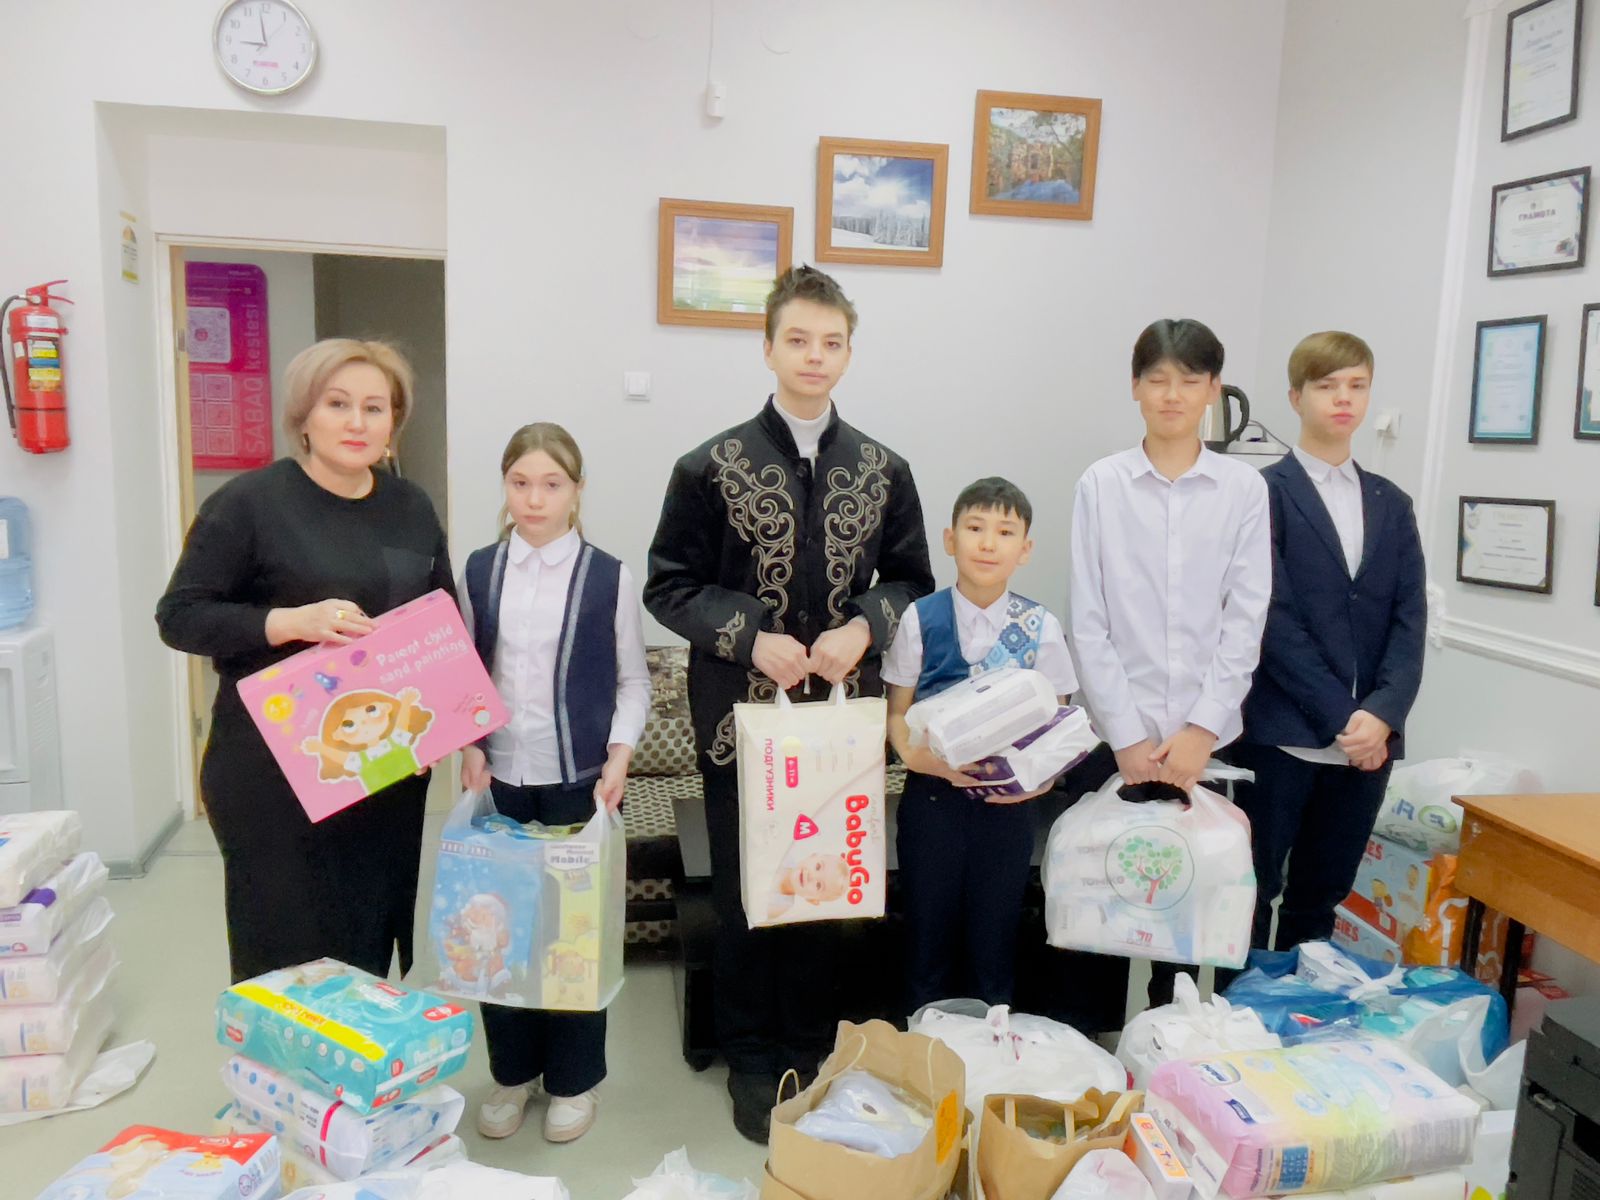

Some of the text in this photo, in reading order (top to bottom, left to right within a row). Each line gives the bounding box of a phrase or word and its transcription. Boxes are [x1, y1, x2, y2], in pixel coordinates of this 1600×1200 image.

[244, 7, 252, 17] 11
[230, 19, 241, 29] 10
[230, 54, 238, 64] 8
[292, 61, 299, 71] 4
[245, 68, 252, 77] 7
[262, 77, 269, 86] 6
[1518, 208, 1556, 222] ГРАМОТА
[241, 303, 266, 454] SABAQ kestesi
[375, 624, 454, 667] Parent child
[379, 638, 470, 685] sand painting
[763, 737, 775, 812] ПОДГУЗНИКИ
[799, 821, 811, 835] M
[840, 794, 870, 905] BabyGo
[550, 855, 591, 864] Mobile
